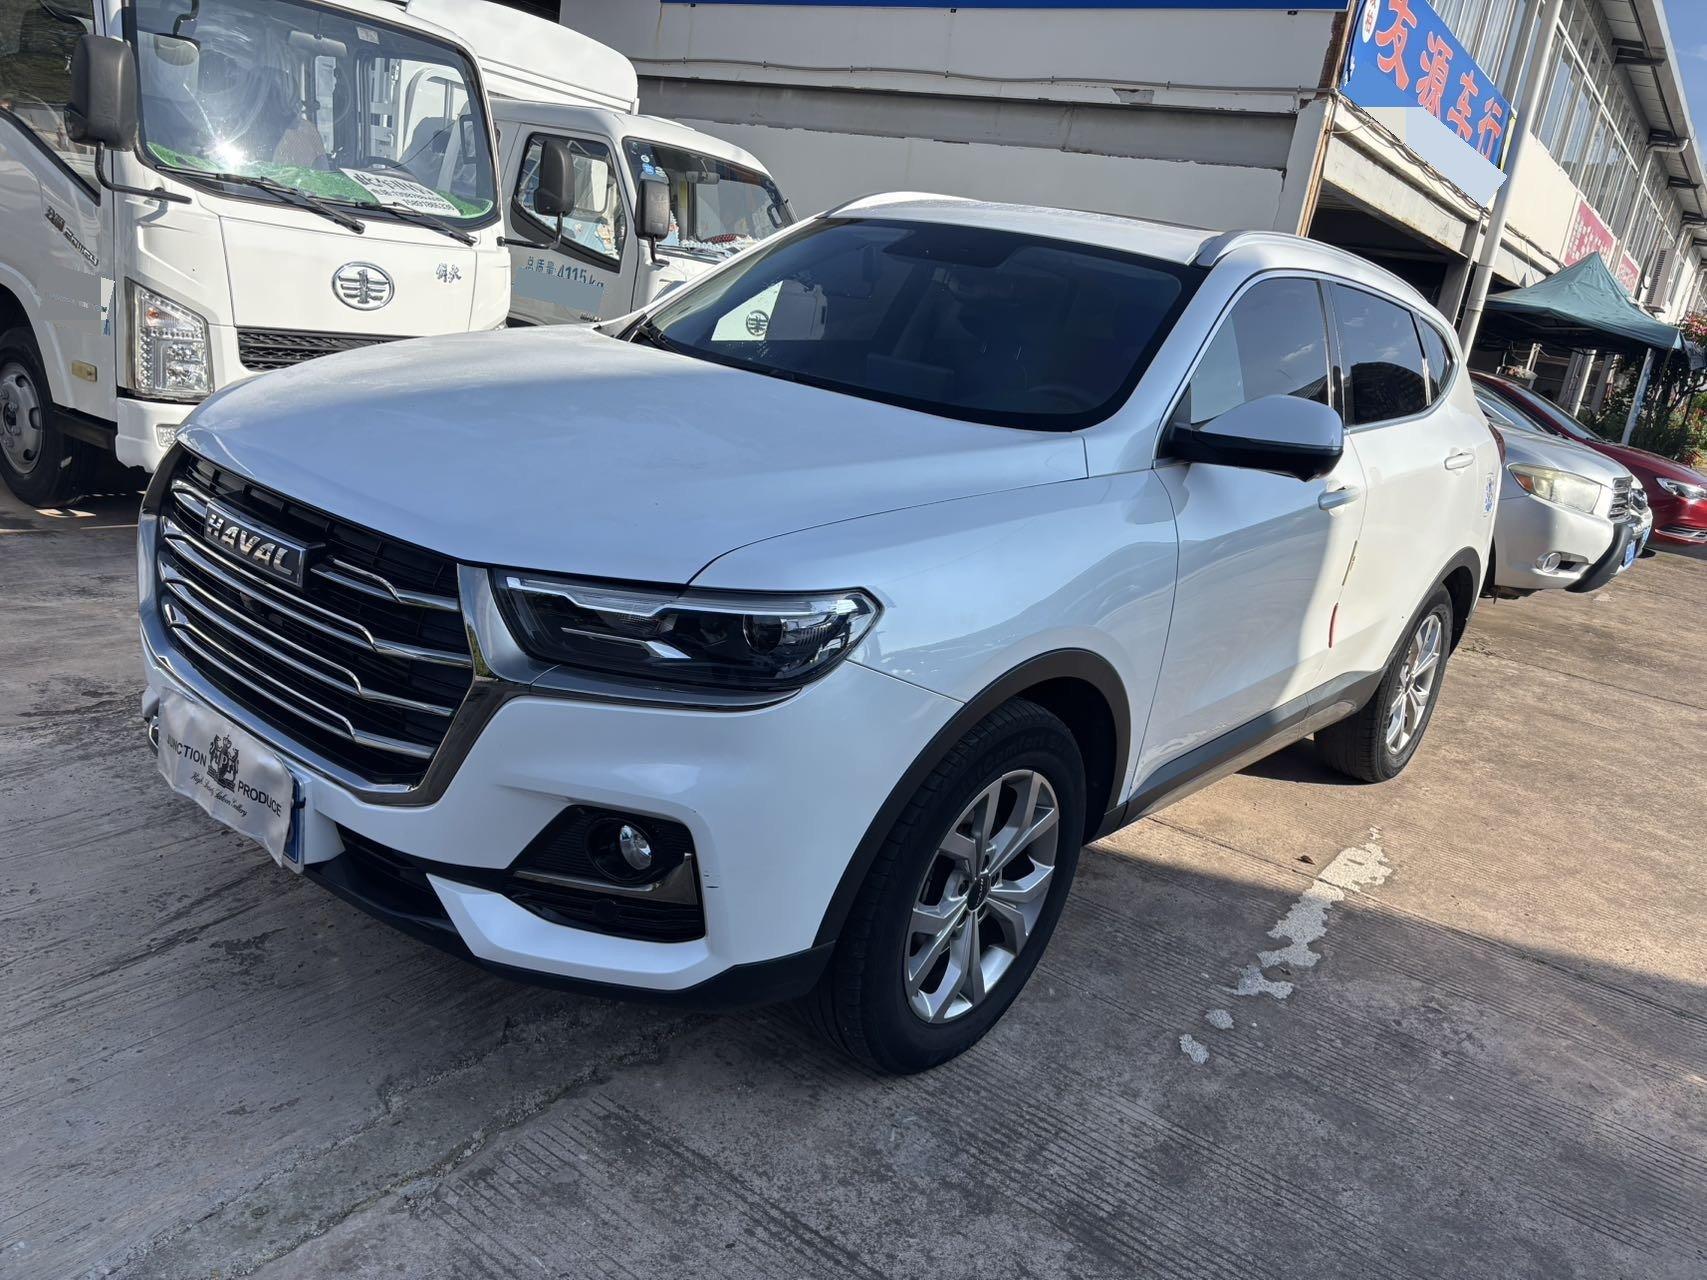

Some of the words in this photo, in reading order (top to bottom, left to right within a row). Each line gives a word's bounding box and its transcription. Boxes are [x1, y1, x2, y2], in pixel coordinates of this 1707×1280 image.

[207, 514, 293, 576] HAVAL
[166, 733, 208, 768] JUNCTION
[237, 779, 282, 818] PRODUCE
